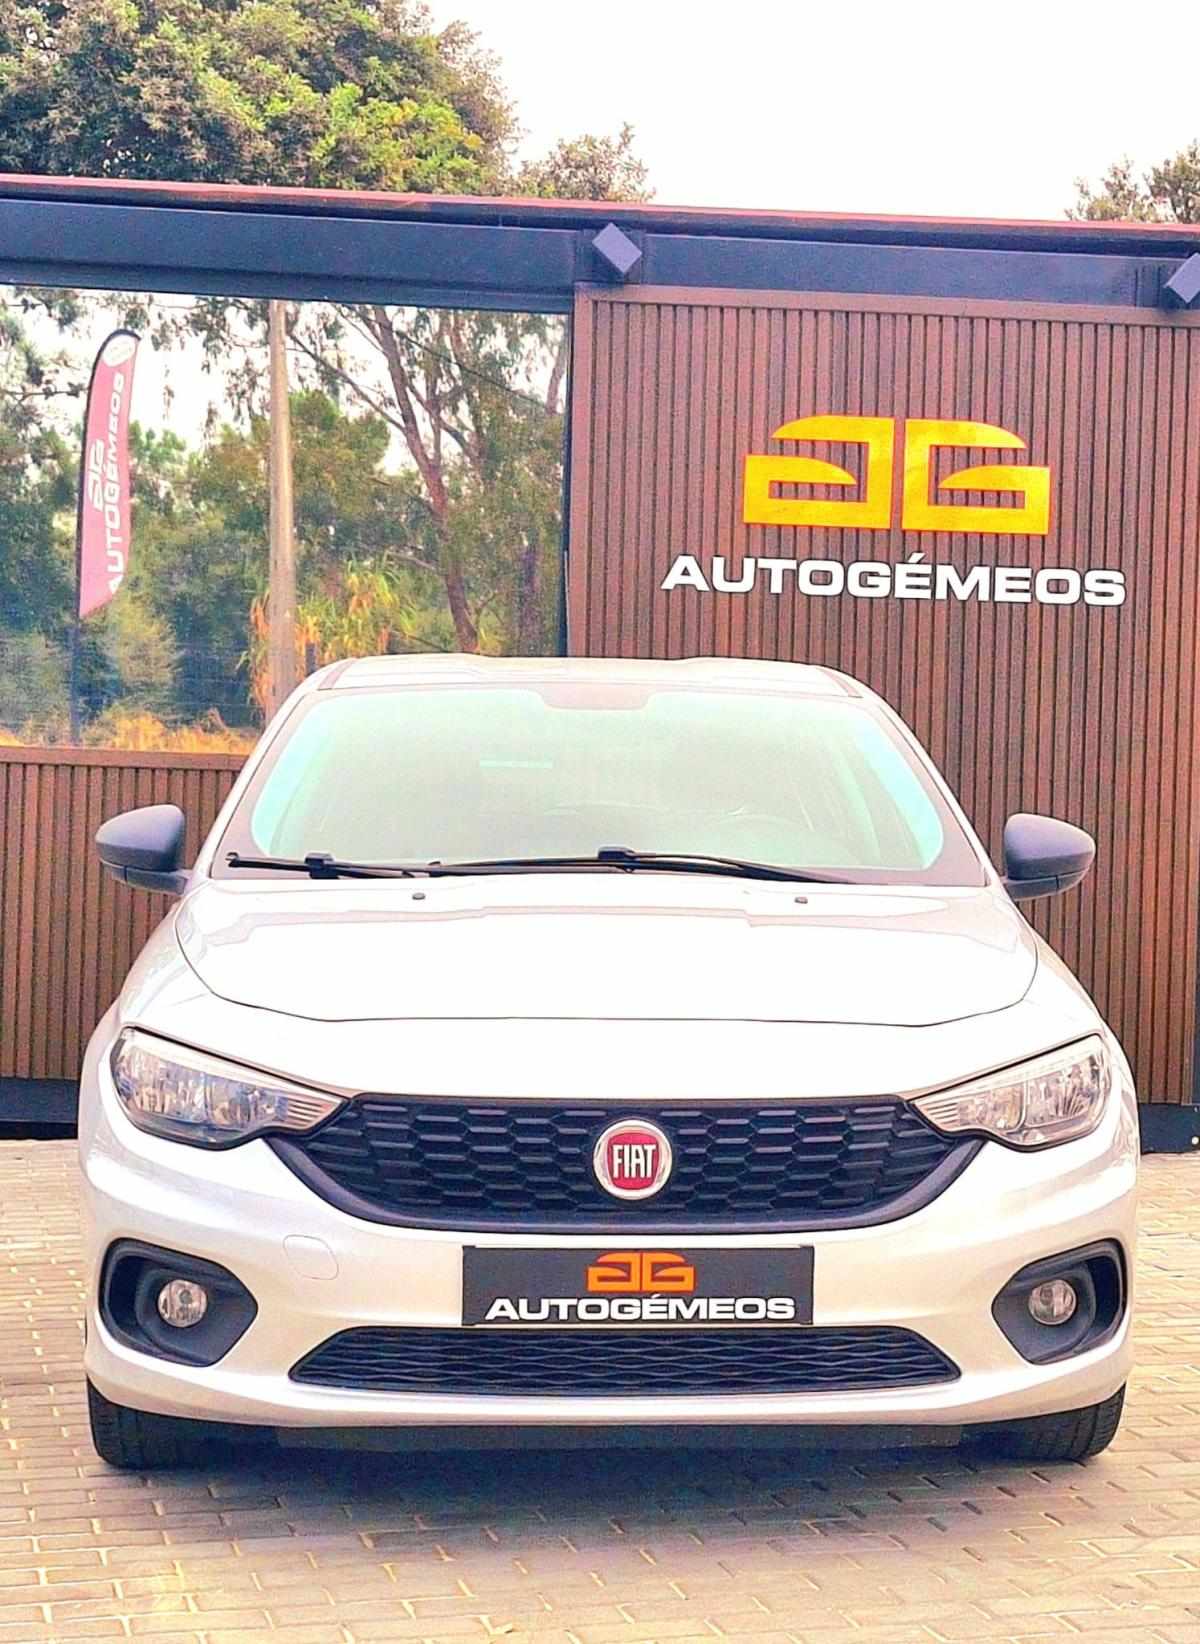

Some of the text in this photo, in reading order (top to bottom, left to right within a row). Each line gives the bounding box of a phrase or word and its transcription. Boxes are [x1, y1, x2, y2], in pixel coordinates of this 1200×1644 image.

[661, 553, 1127, 606] AUTOGÉMEOS
[612, 1144, 657, 1179] FIAT
[484, 1293, 796, 1321] AUTOGÉMEOS
